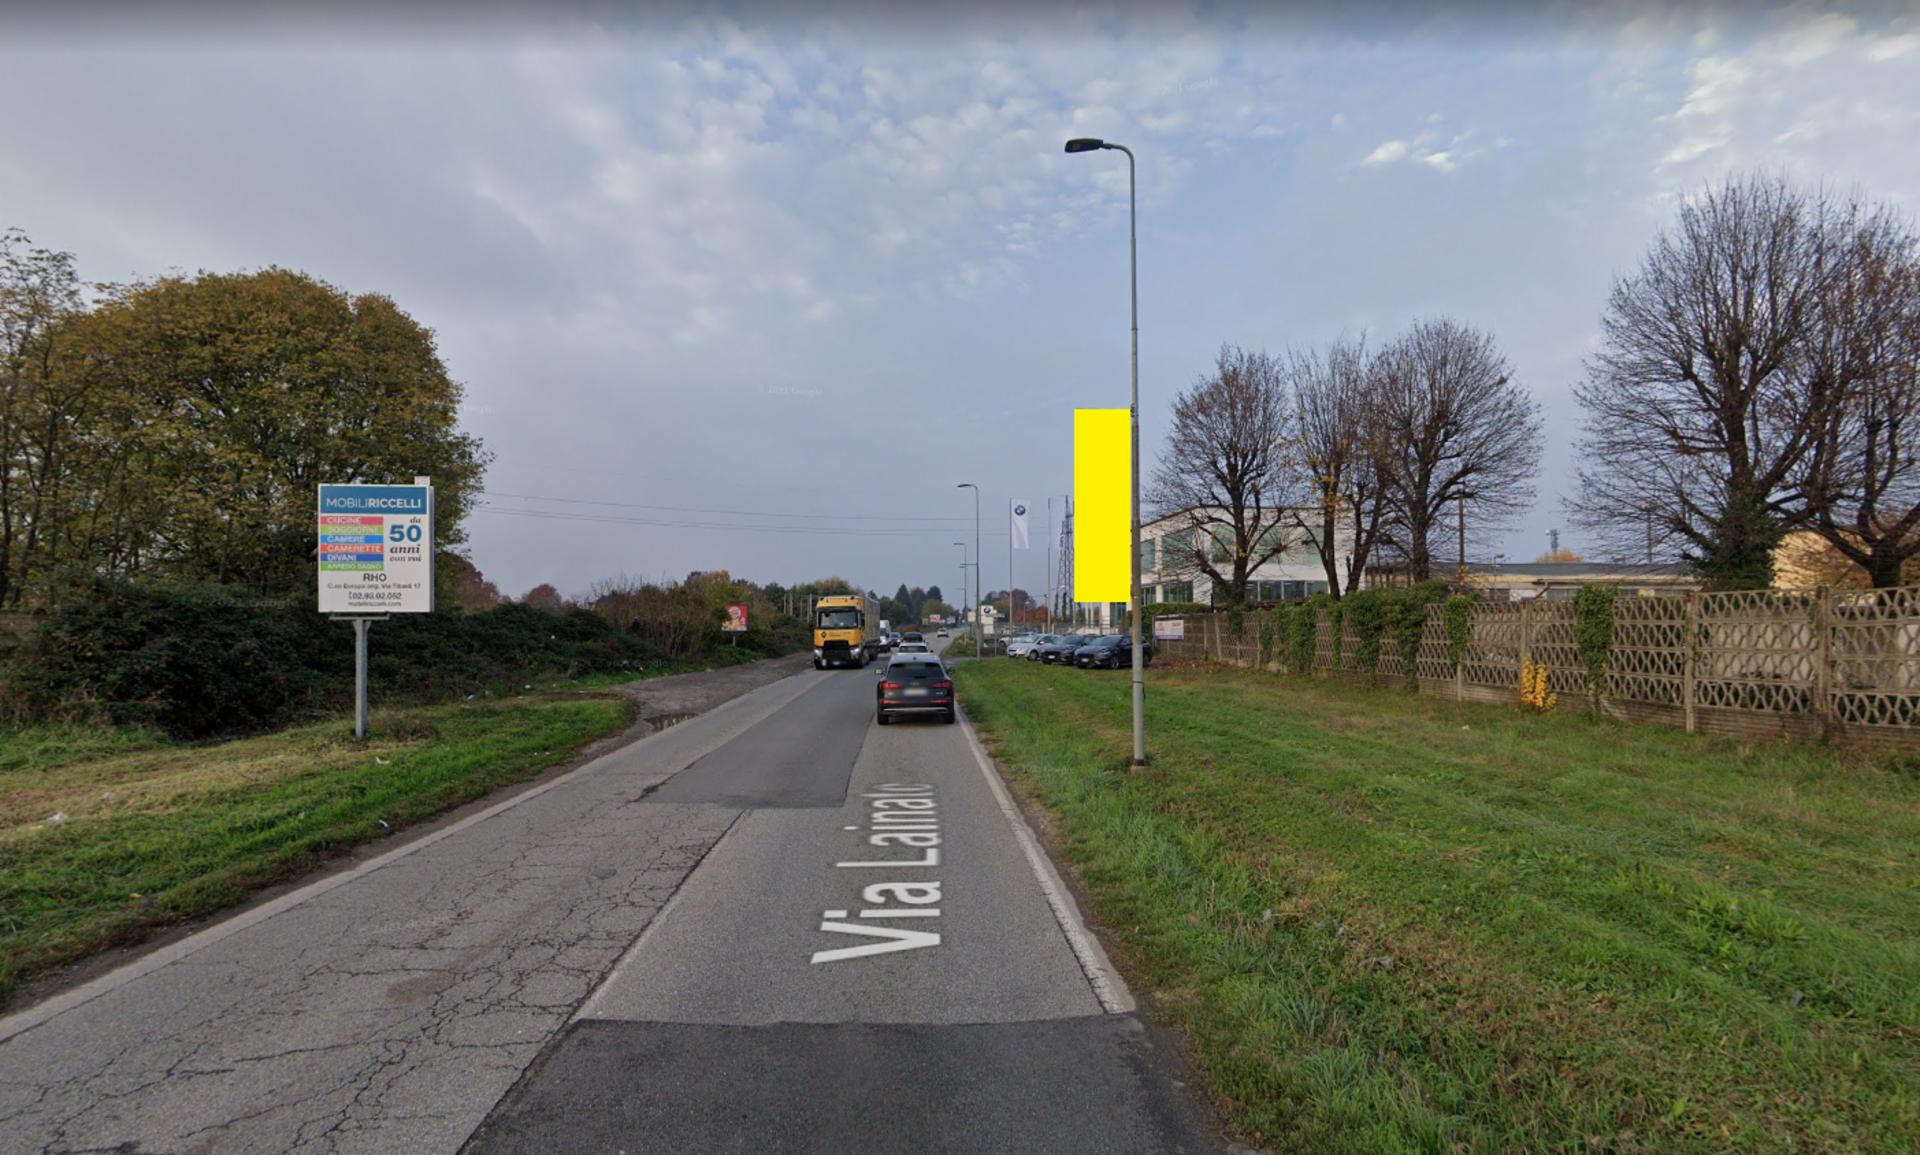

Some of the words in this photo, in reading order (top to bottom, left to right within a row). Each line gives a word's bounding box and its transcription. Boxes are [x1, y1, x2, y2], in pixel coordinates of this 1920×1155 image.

[326, 497, 421, 509] MOBILIRICCELLI
[409, 515, 421, 524] da
[389, 524, 422, 543] 50
[327, 544, 382, 553] CAMERETTE
[389, 543, 421, 554] anni
[363, 573, 387, 582] RHO
